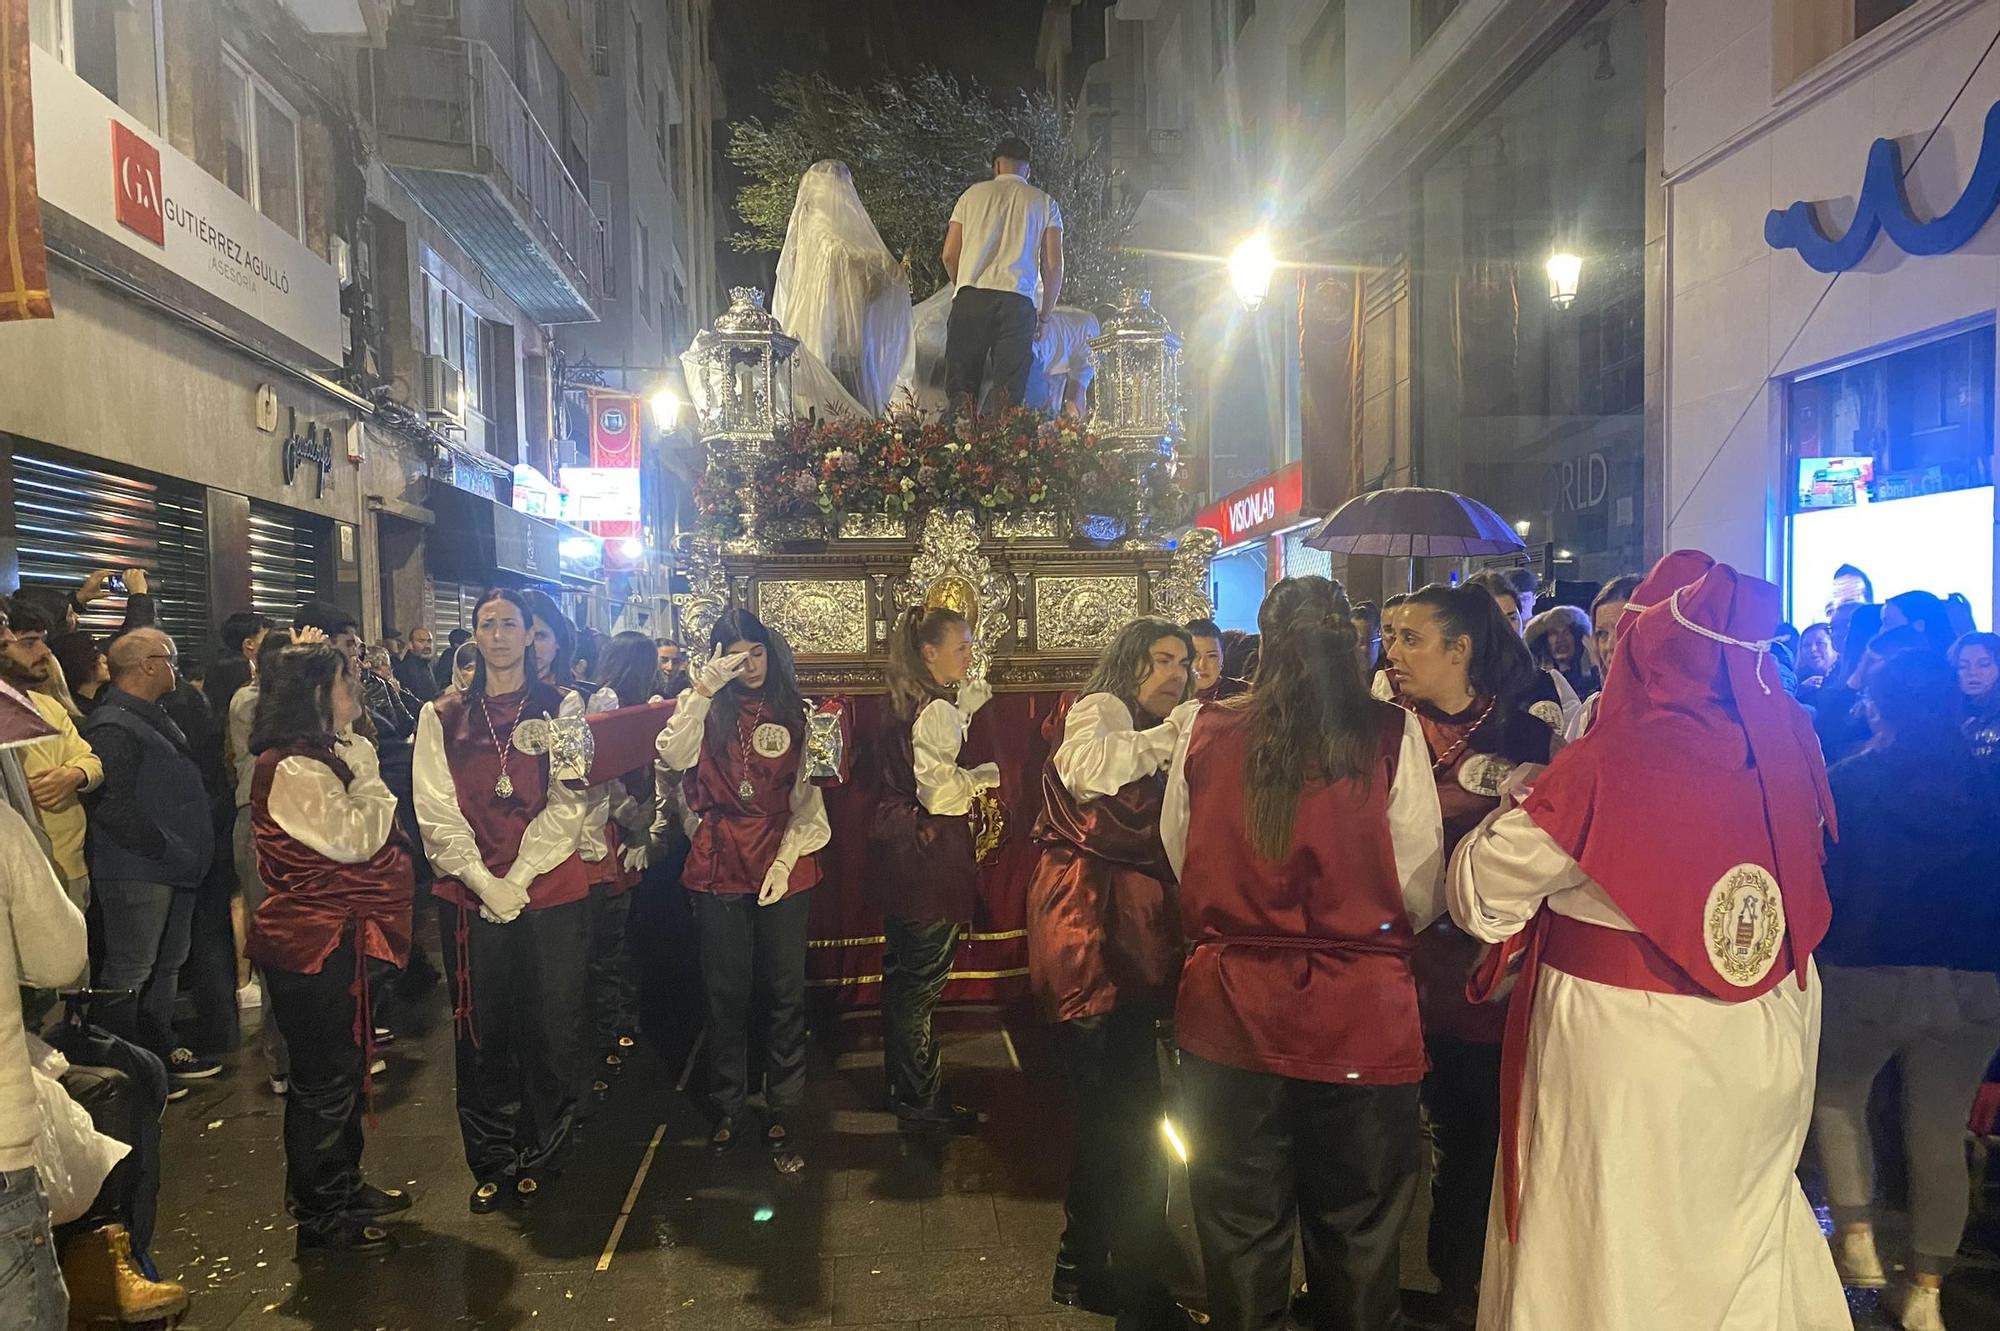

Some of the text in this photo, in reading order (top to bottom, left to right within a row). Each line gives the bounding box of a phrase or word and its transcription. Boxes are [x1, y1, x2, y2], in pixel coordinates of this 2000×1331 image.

[164, 198, 290, 294] GUTIÉRREZ AGULLÓ
[1229, 487, 1275, 534] VISIONLAB
